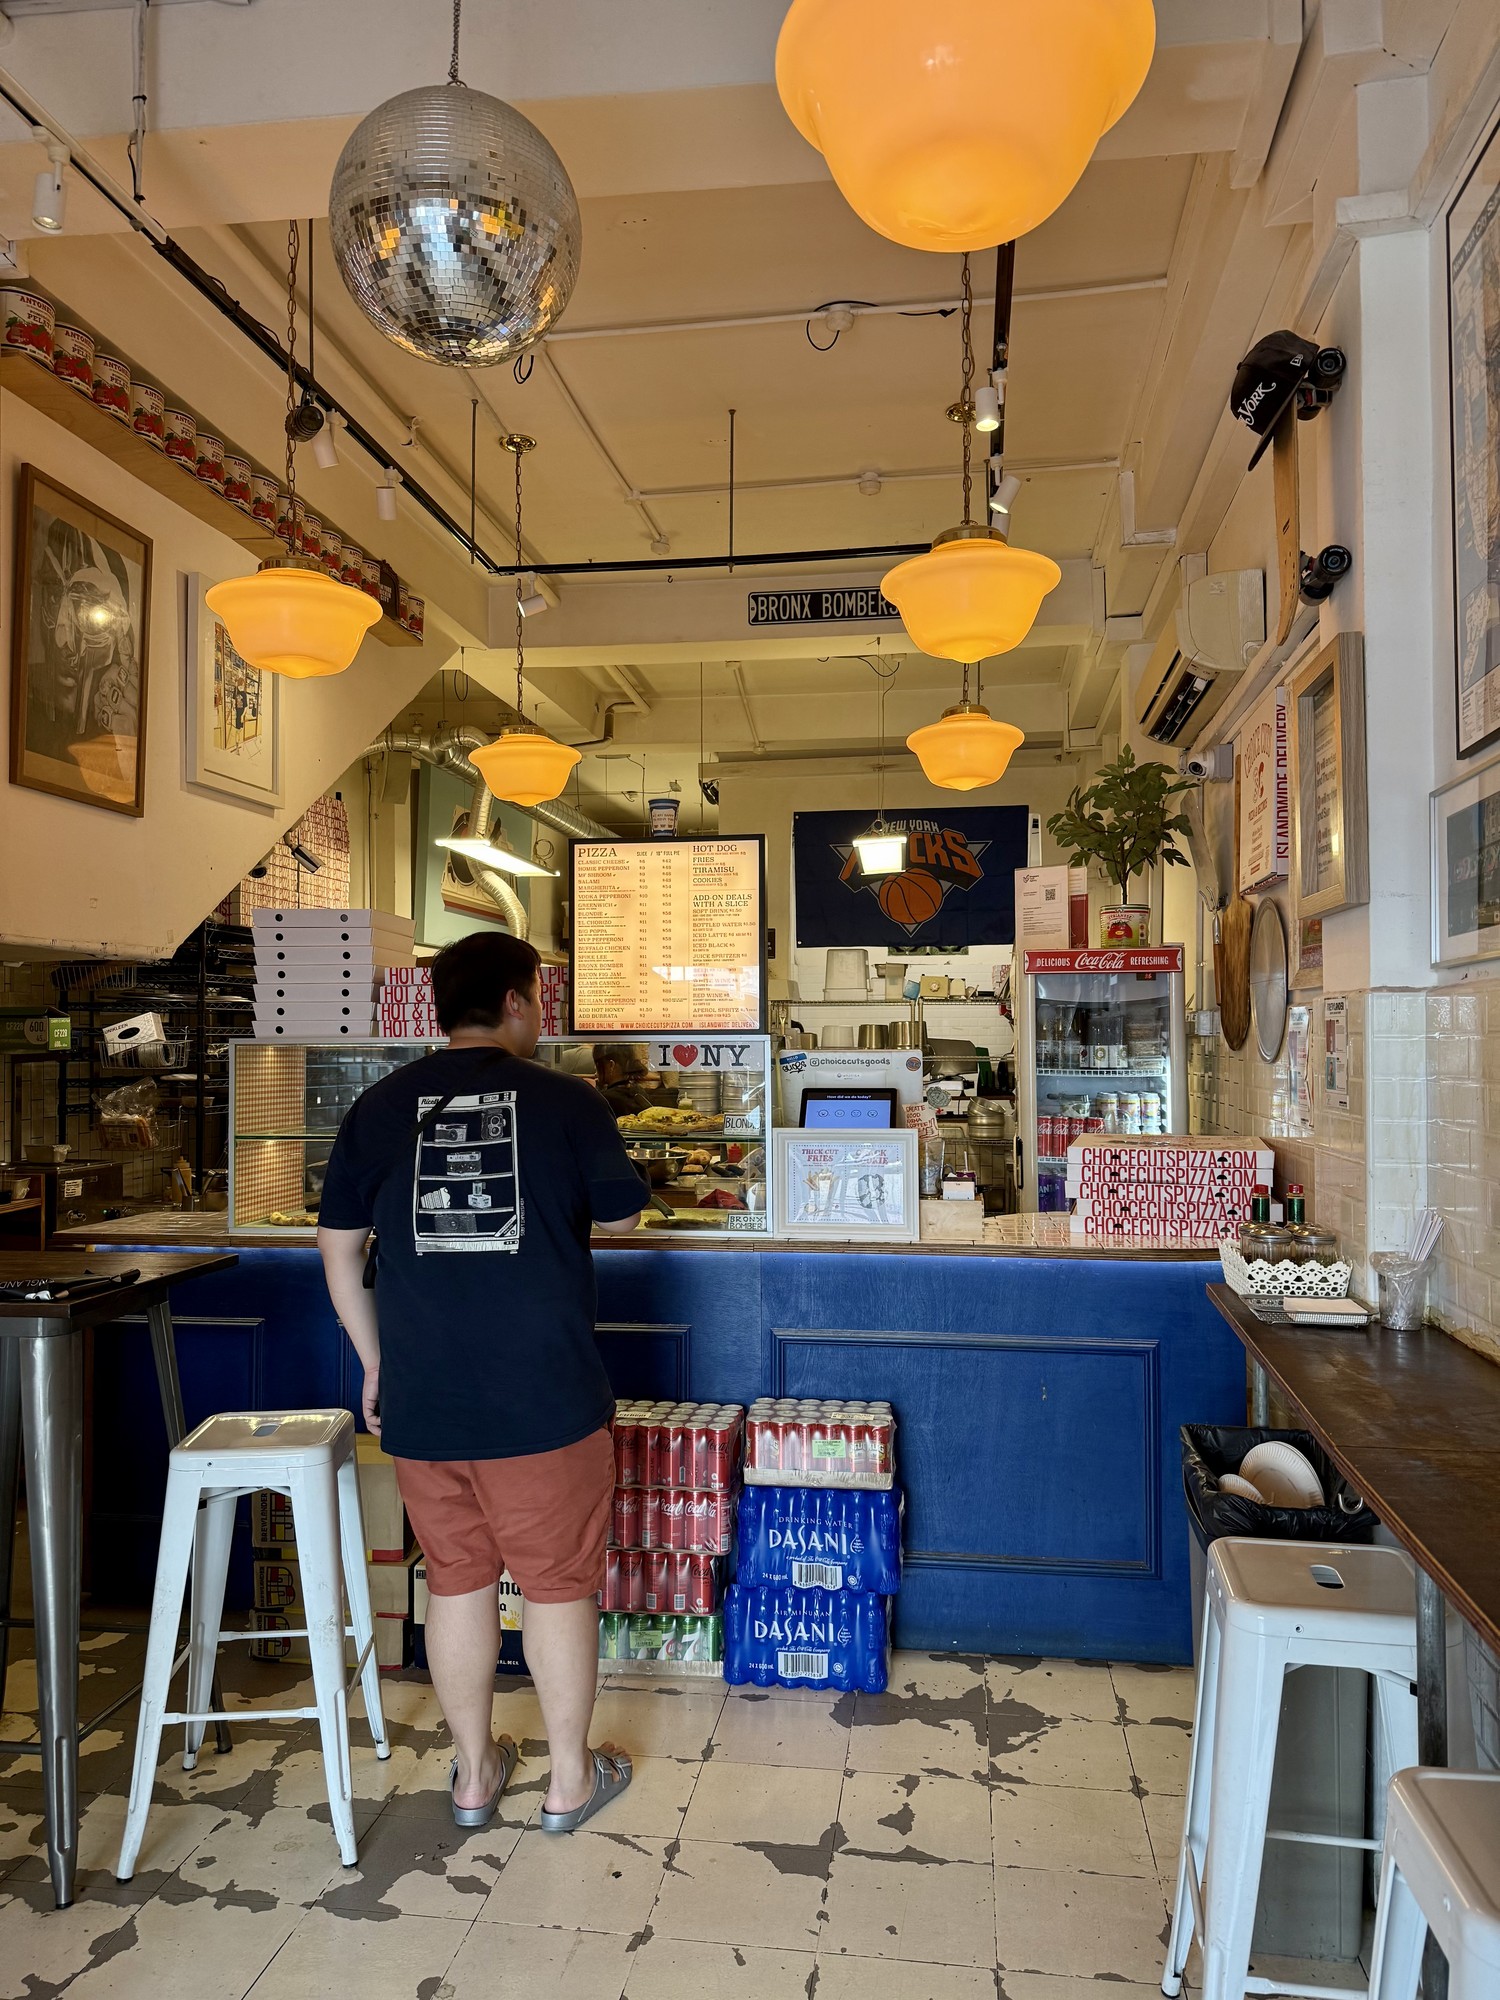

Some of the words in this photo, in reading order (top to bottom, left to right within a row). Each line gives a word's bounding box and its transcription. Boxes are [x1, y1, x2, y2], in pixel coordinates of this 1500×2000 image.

[1237, 382, 1276, 426] YORK
[758, 594, 812, 621] BRONX
[884, 819, 908, 832] NEW
[909, 820, 940, 832] YORK
[578, 848, 617, 858] PIZZA
[716, 844, 737, 852] DOG
[692, 866, 735, 874] TIRAMISU
[1036, 958, 1071, 967] DELICIOUS
[1074, 952, 1128, 970] Coca-Cola
[1130, 956, 1169, 966] REFRESHING
[390, 968, 415, 985] HOT
[421, 967, 432, 985] &
[549, 966, 568, 984] PIE
[384, 986, 408, 1004] HOT
[415, 986, 426, 1003] &
[541, 983, 560, 1002] PIE
[381, 1003, 406, 1020] HOT
[412, 1003, 423, 1020] &
[383, 1021, 408, 1037] HOT
[414, 1020, 425, 1037] &
[658, 1044, 670, 1066] I
[700, 1044, 750, 1067] NY
[820, 1057, 890, 1067] choicecutsgoods
[725, 1116, 760, 1130] BLON
[1082, 1148, 1257, 1169] CHOICECUTSPIZZA.COM
[1081, 1165, 1257, 1187] CHOICECUTSPIZZA.COM
[1079, 1182, 1254, 1205] CHOICECUTSPIZZA.COM
[1091, 1200, 1252, 1221] CHOICECUTSPIZZA.CO
[730, 1222, 762, 1230] BOMBER
[1084, 1216, 1241, 1239] CHOICECUTSPIZZA.C
[778, 1516, 822, 1525] DRINKING
[824, 1519, 853, 1529] WATER
[769, 1524, 847, 1556] DASANI
[754, 1616, 834, 1646] DASANI
